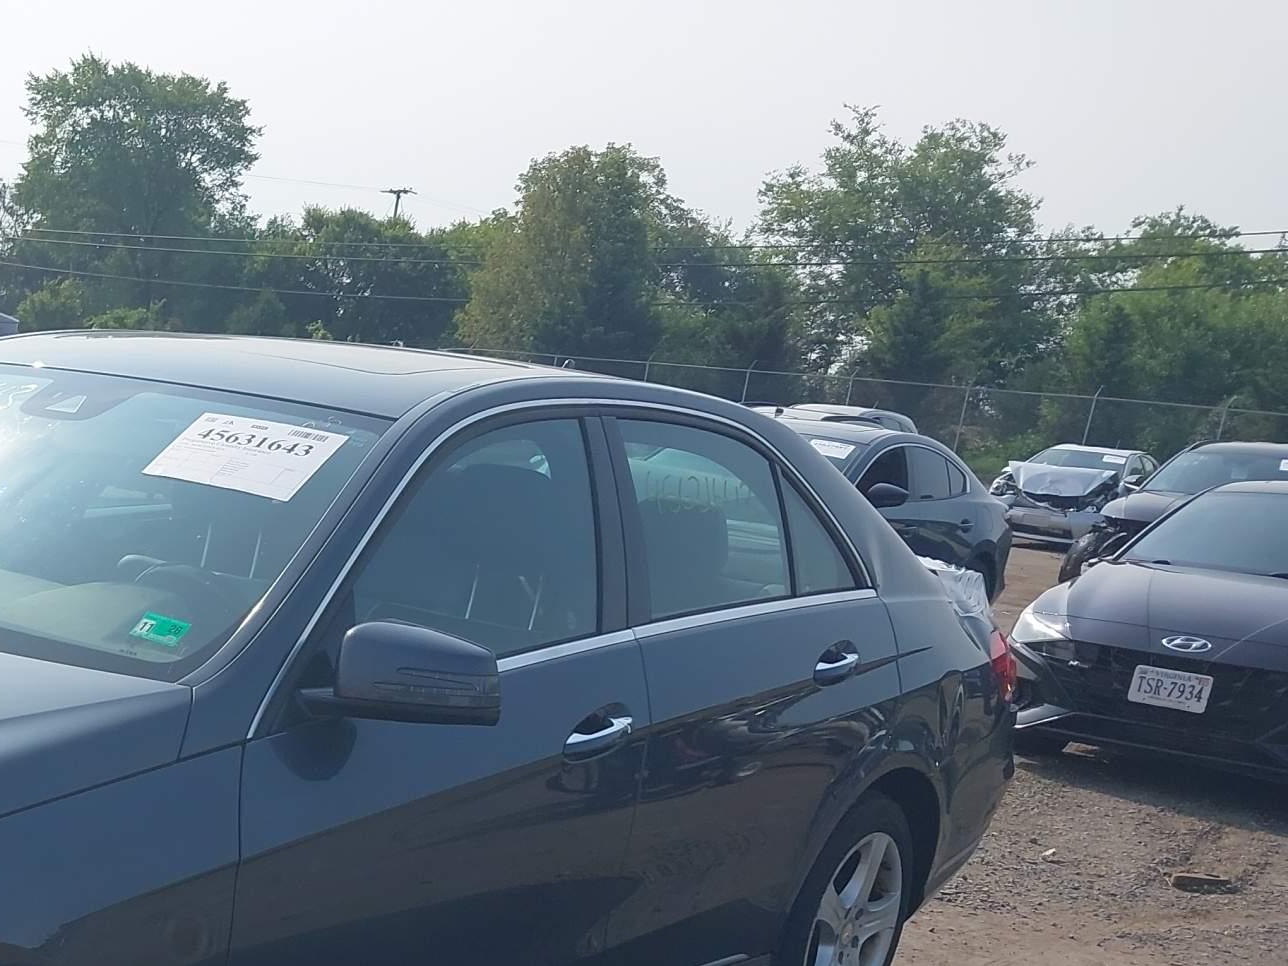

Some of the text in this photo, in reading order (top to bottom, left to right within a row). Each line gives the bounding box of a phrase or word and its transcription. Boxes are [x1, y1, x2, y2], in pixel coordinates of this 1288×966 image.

[197, 428, 315, 457] 45631643
[139, 621, 155, 633] 11
[1155, 669, 1192, 682] VIRGINIA
[1136, 675, 1205, 703] TSR-7934
